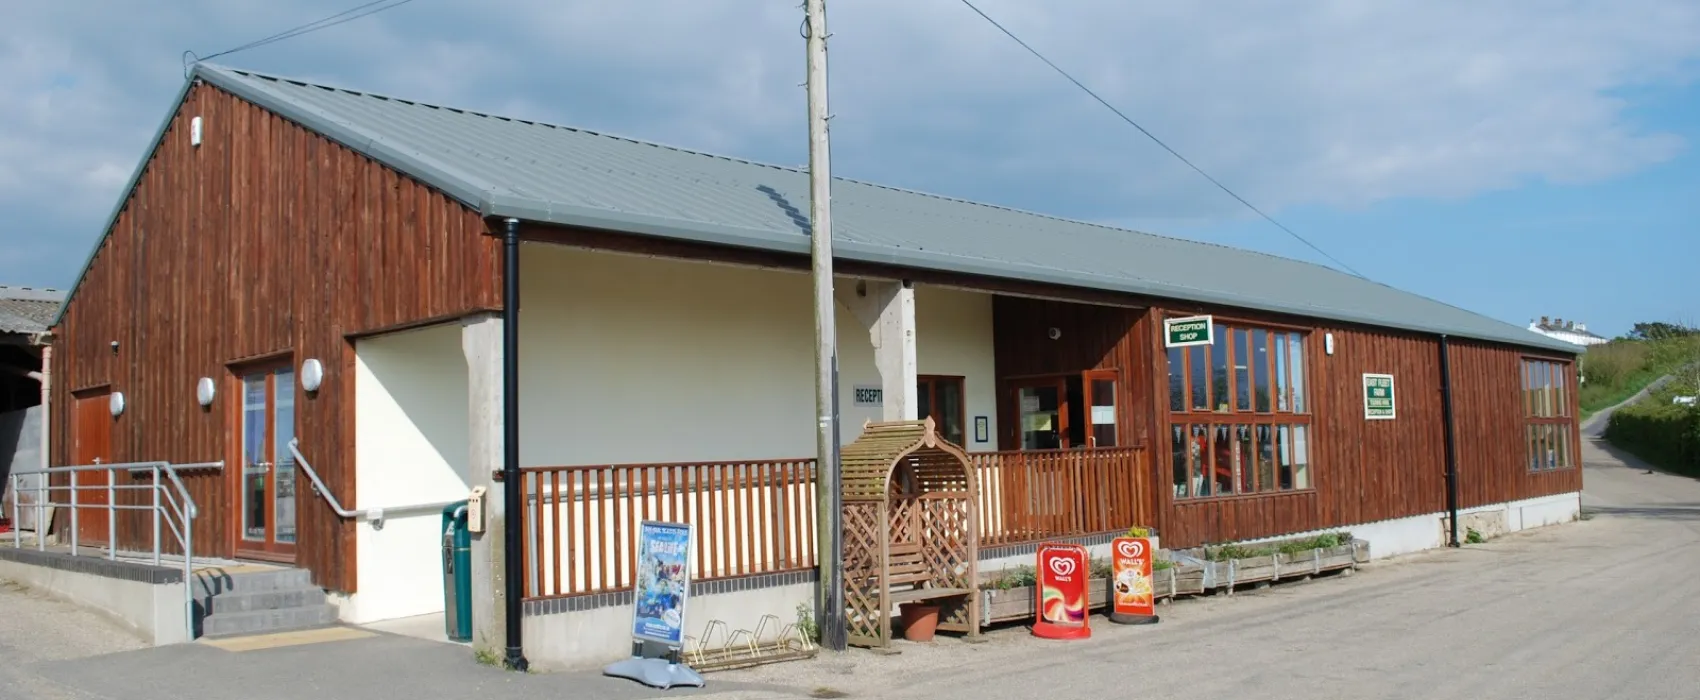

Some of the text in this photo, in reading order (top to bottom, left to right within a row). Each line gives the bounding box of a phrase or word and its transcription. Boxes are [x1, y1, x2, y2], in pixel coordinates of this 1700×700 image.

[1170, 322, 1206, 332] RECEPTION
[1180, 332, 1198, 341] SHOP
[1119, 558, 1144, 566] WALL'S
